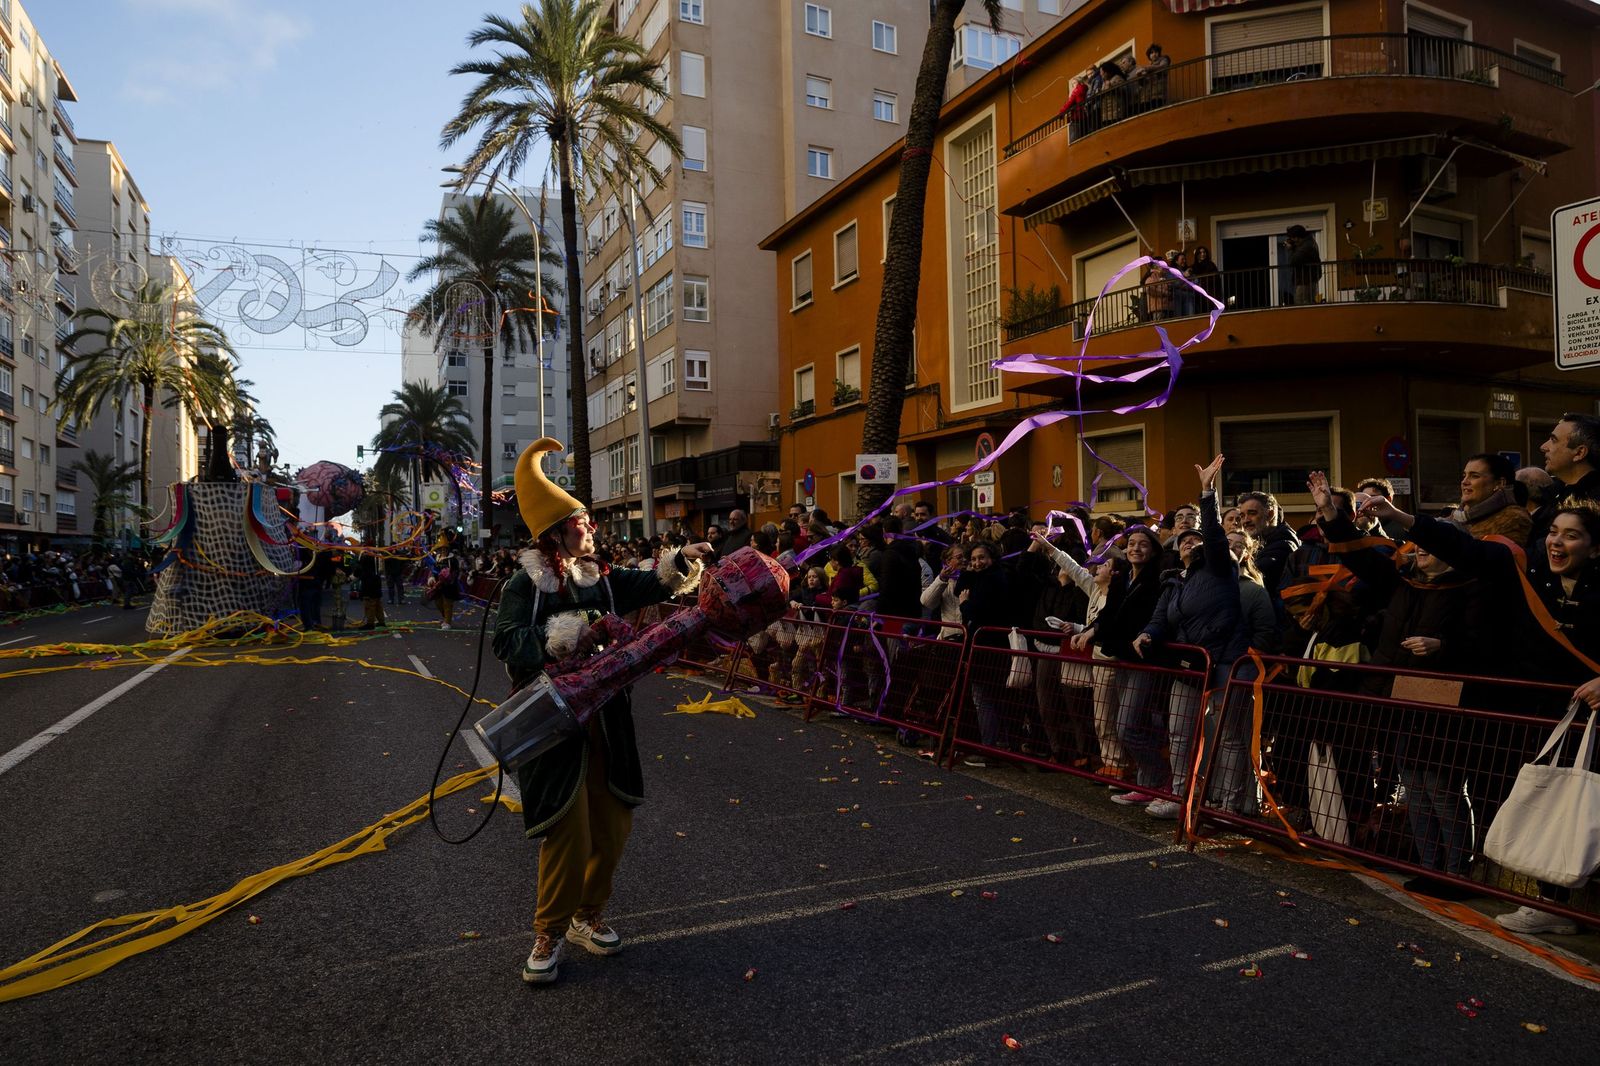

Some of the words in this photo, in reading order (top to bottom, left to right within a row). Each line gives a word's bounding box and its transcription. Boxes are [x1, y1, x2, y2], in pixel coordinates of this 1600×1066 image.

[1573, 211, 1600, 226] ATE
[1567, 311, 1588, 319] CARGA
[1567, 316, 1600, 326] BICICLETA
[1563, 349, 1599, 359] VELOCIDAD
